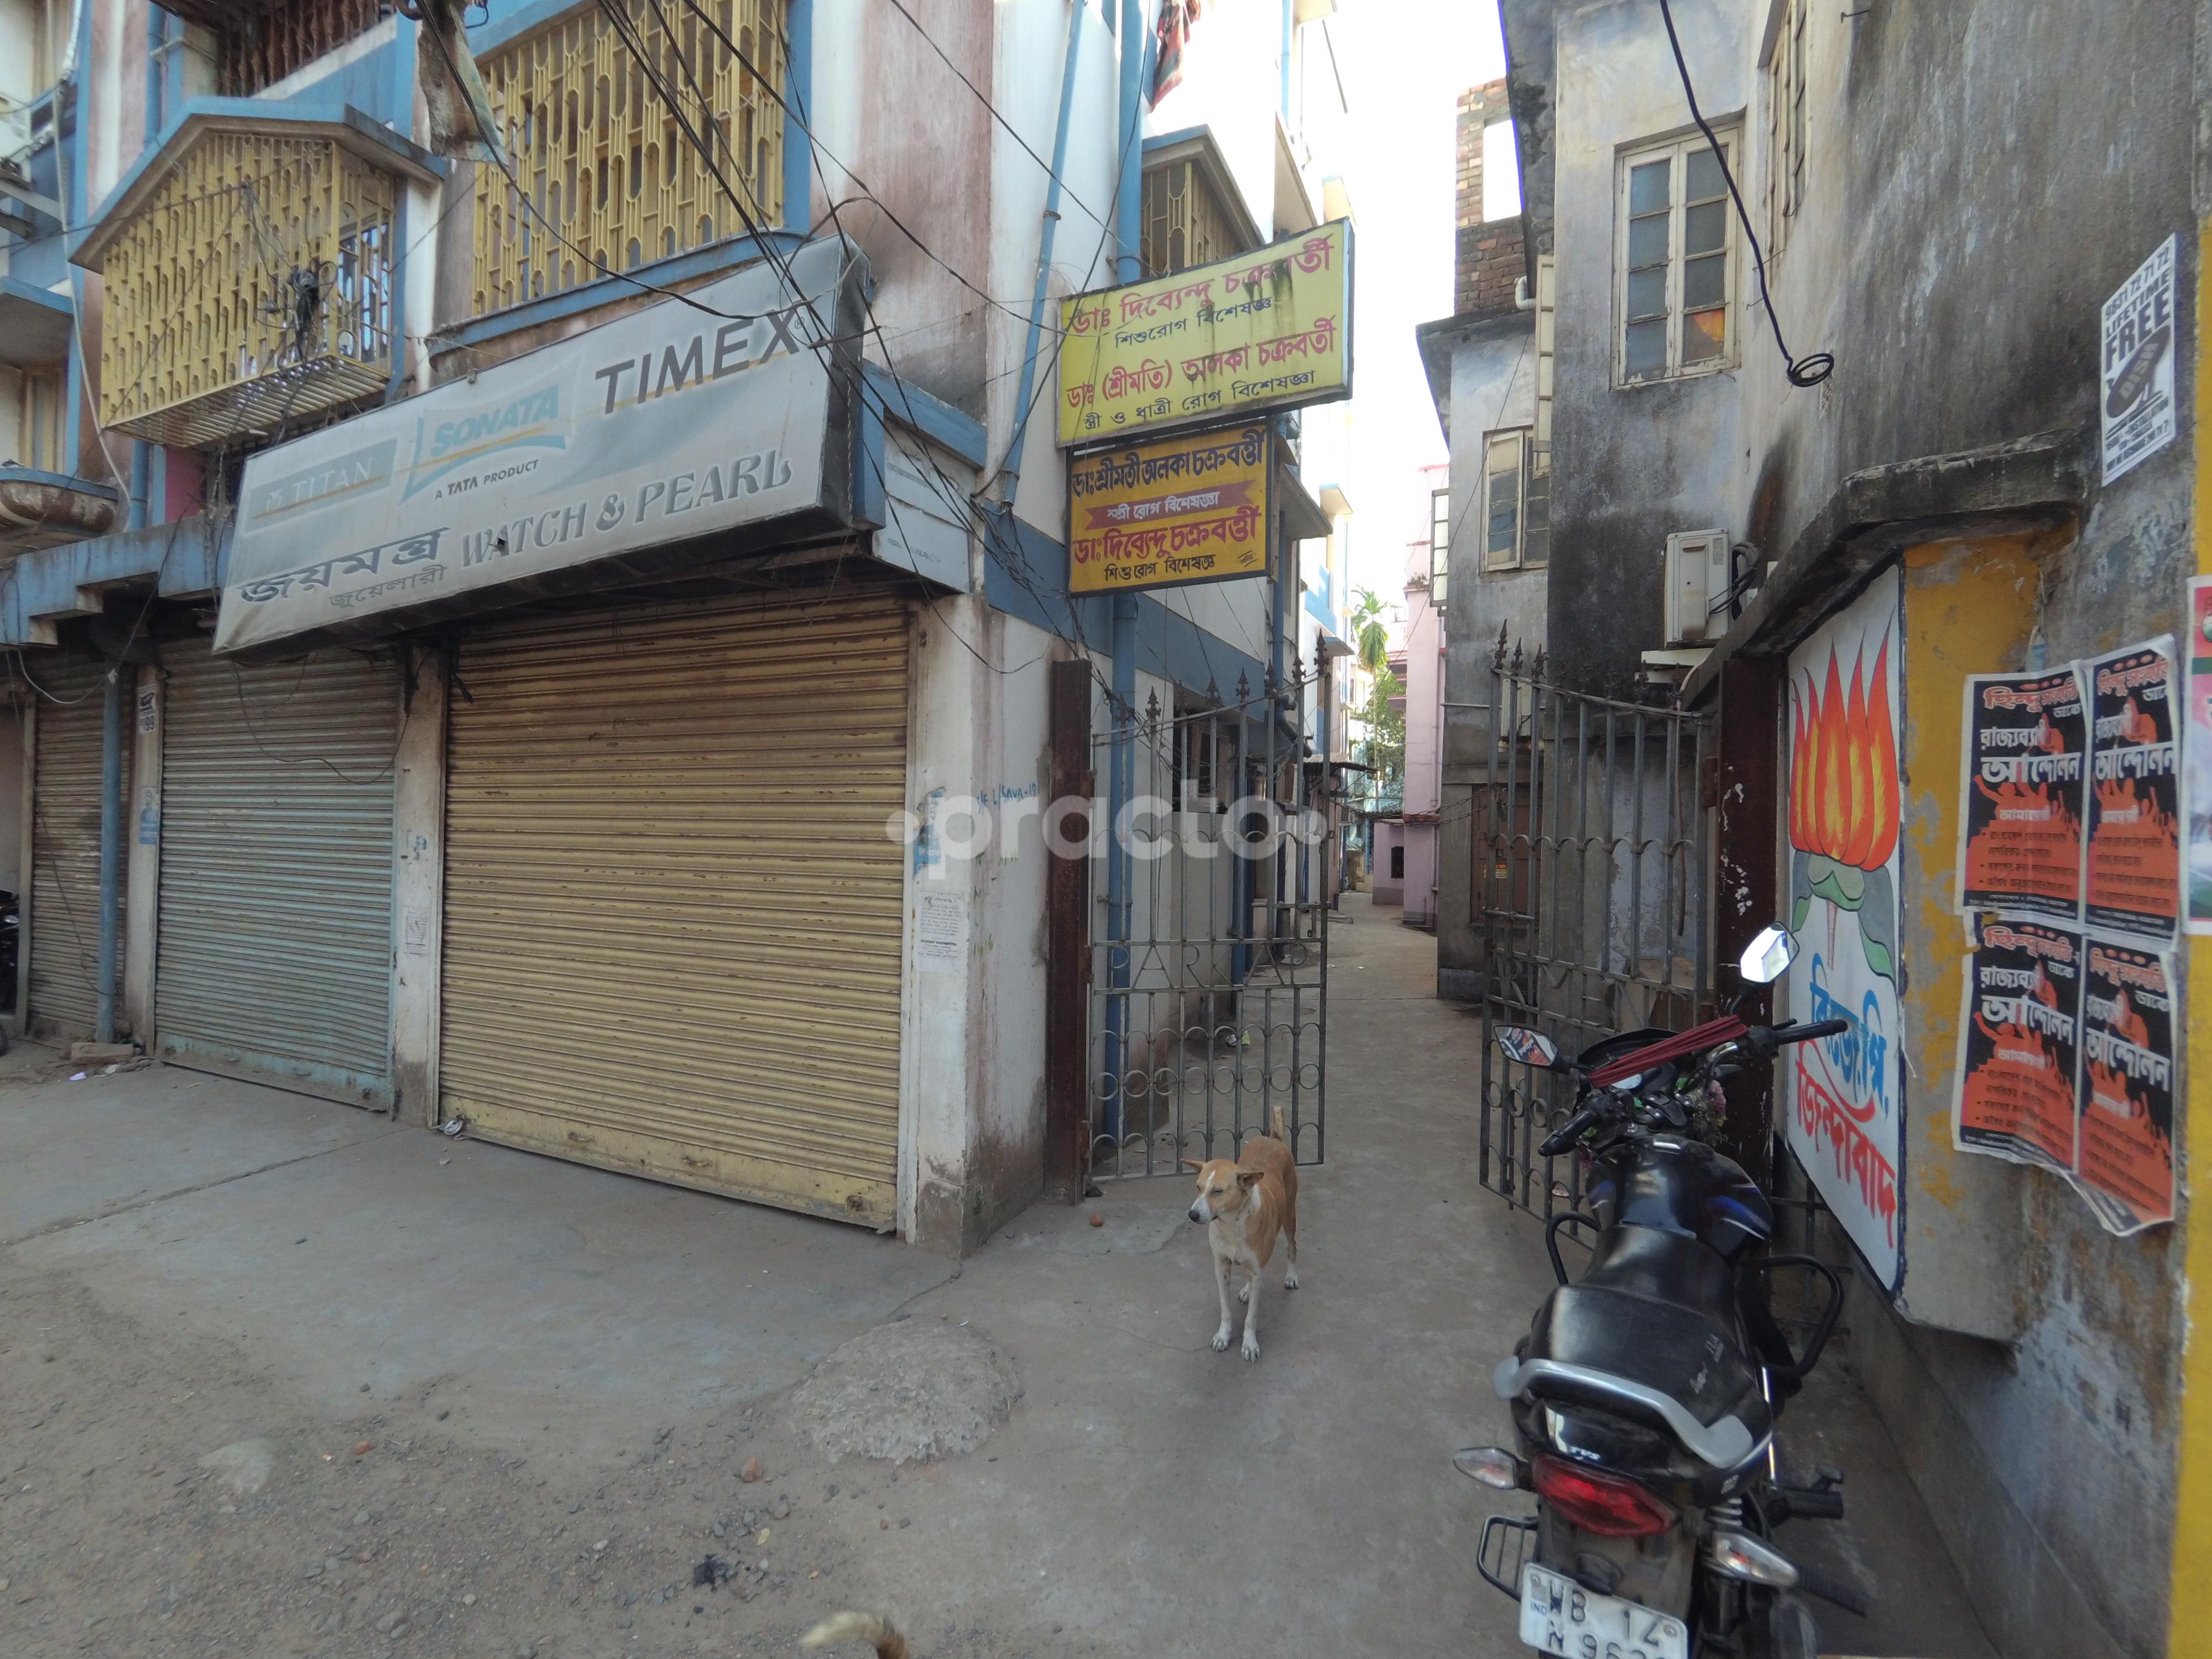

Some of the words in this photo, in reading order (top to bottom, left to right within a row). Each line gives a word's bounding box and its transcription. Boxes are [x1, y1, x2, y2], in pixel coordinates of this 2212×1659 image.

[2106, 270, 2169, 336] LIFETIME
[1114, 318, 1187, 348] শিশুরোগ
[2106, 289, 2169, 374] FREE
[594, 309, 802, 415] TIMEX
[1181, 343, 1250, 383] অলকা
[2119, 343, 2158, 400] DISH
[431, 383, 560, 455] SONATA
[1181, 389, 1222, 411] রোগ
[293, 457, 372, 502] TITAN
[435, 489, 443, 500] A
[447, 475, 479, 497] TATA
[483, 458, 539, 486] PRODUCT
[1142, 452, 1190, 486] অলকা
[461, 500, 588, 567] WATCH
[595, 492, 627, 531] &
[633, 448, 794, 524] PEARL
[1133, 502, 1161, 520] রোগ
[1980, 753, 2082, 783] আন্দোলন
[2095, 740, 2174, 780] আন্দোলন
[1981, 995, 2074, 1046] আন্দোলন
[2086, 1026, 2171, 1093] আন্দোলন
[1570, 1446, 1601, 1460] TVS
[1530, 1601, 1547, 1616] IND
